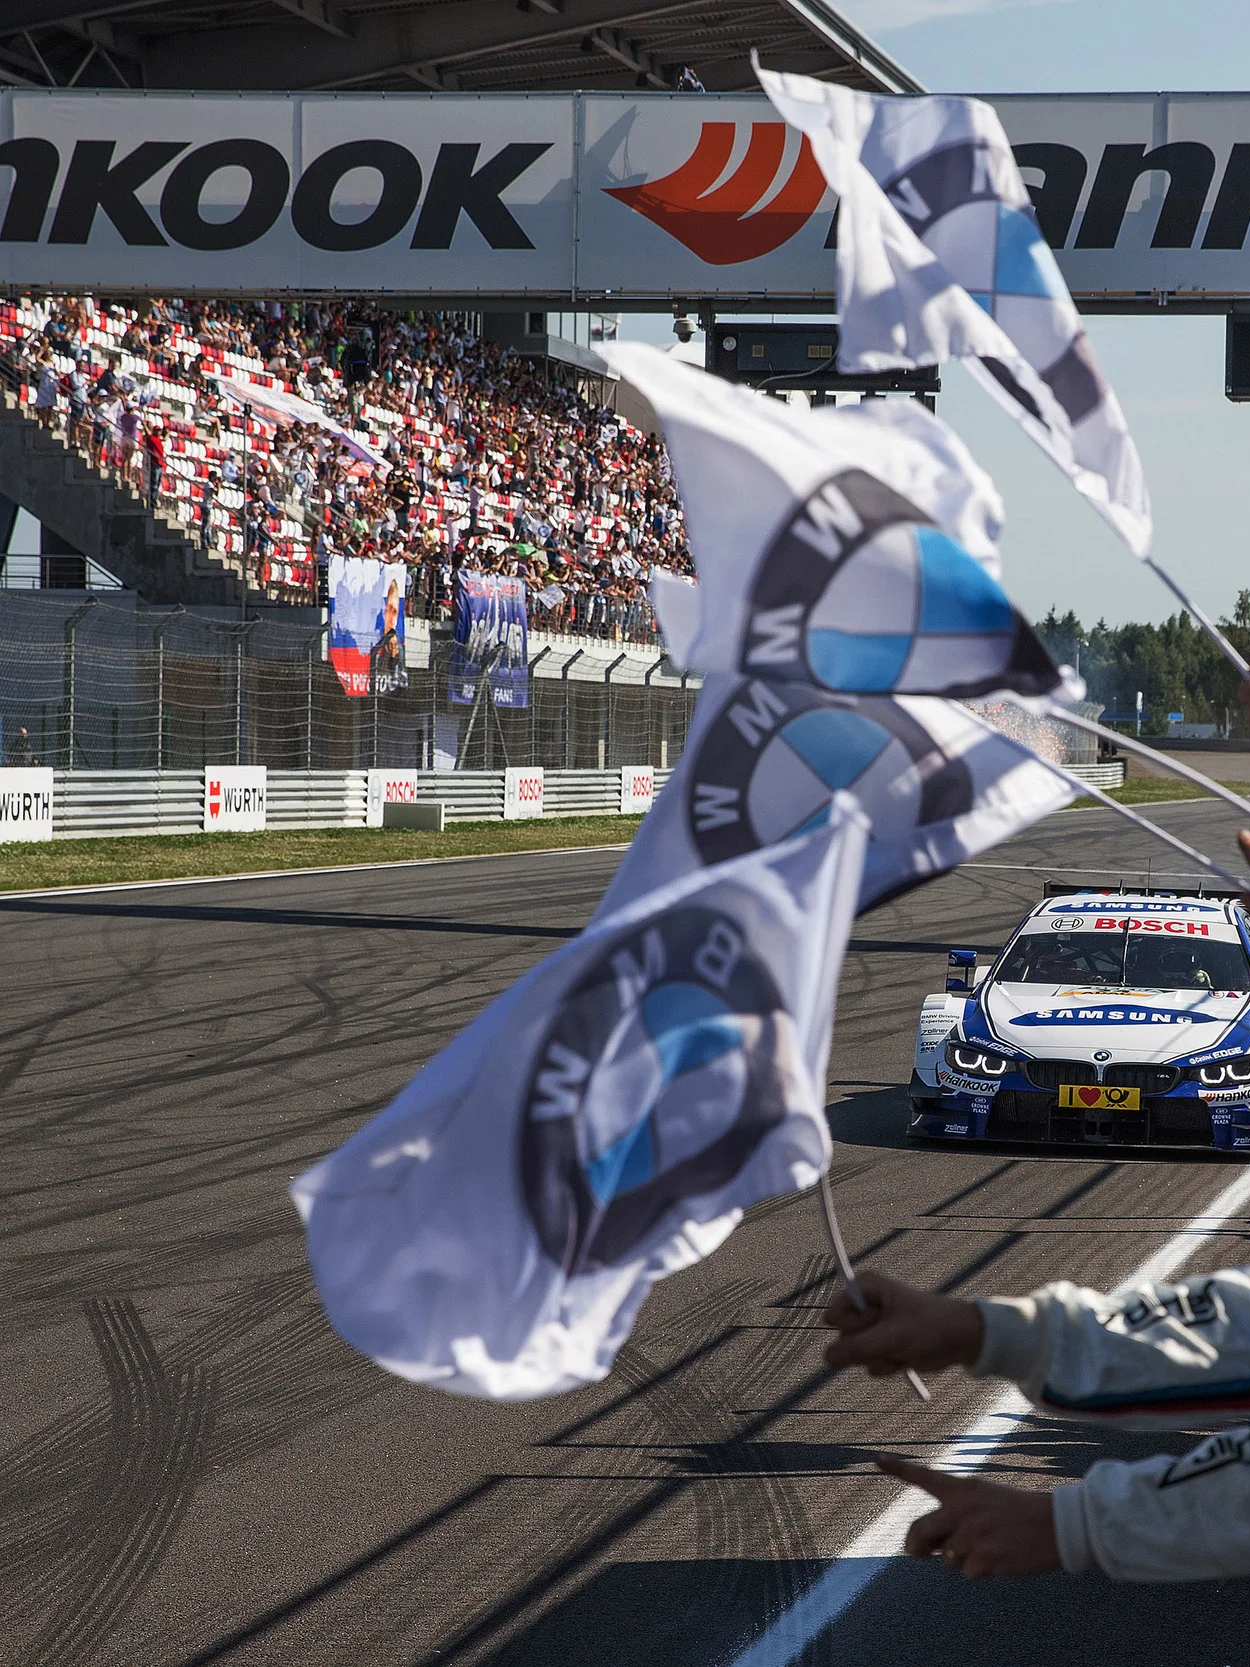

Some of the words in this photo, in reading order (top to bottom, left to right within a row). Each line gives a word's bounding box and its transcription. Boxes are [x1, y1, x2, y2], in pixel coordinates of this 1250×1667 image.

[385, 781, 415, 802] BOSCH
[518, 778, 542, 801] BOSCH
[632, 776, 653, 797] BOSCH
[223, 787, 264, 813] WÜRTH
[1070, 902, 1201, 913] SAMSUNG
[1094, 918, 1210, 936] BOSCH
[1035, 1009, 1193, 1025] SAMSUNG
[987, 1042, 1019, 1057] EDGE
[1213, 1046, 1244, 1059] EDGE
